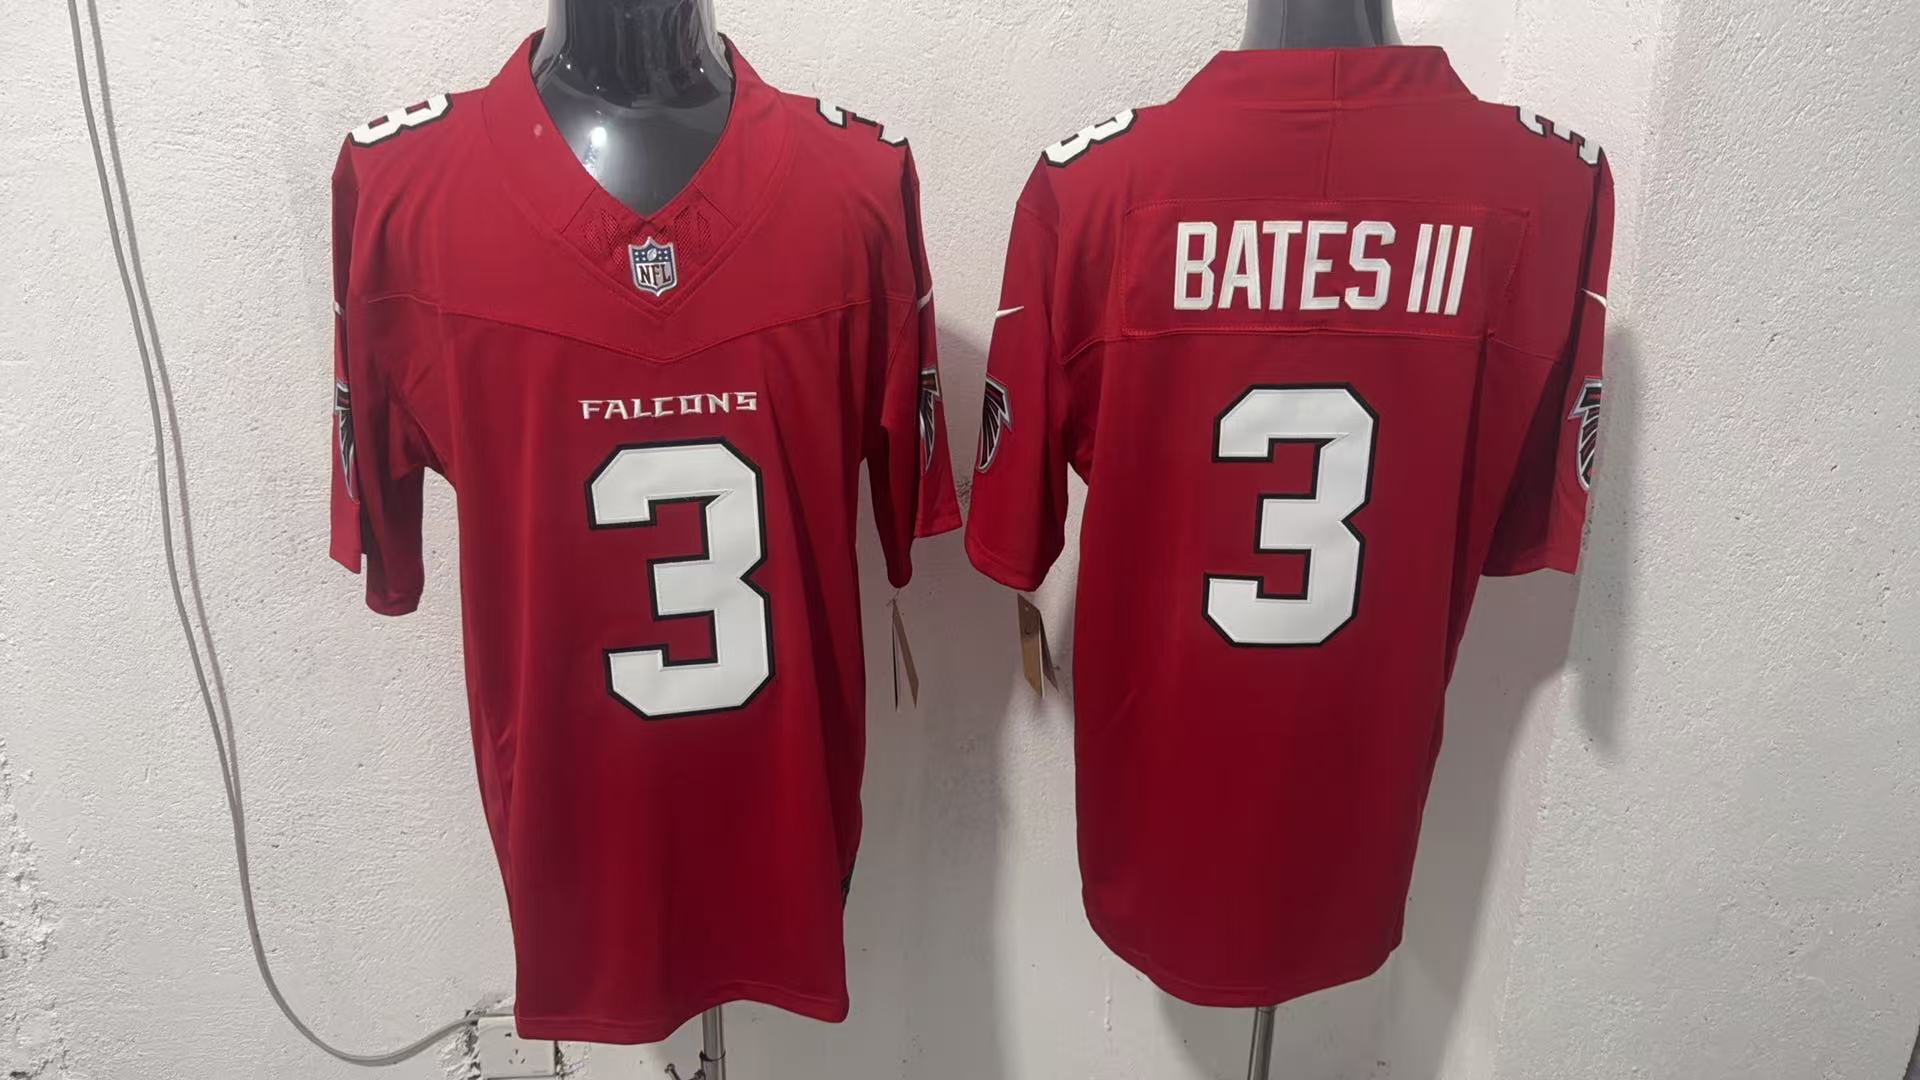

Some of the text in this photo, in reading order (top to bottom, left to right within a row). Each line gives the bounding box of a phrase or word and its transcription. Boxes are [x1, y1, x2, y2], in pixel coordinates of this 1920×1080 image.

[638, 264, 671, 286] NFL
[1173, 219, 1474, 316] BATES III
[578, 391, 757, 420] FALCONS
[1202, 382, 1378, 648] 3
[587, 437, 775, 720] 3
